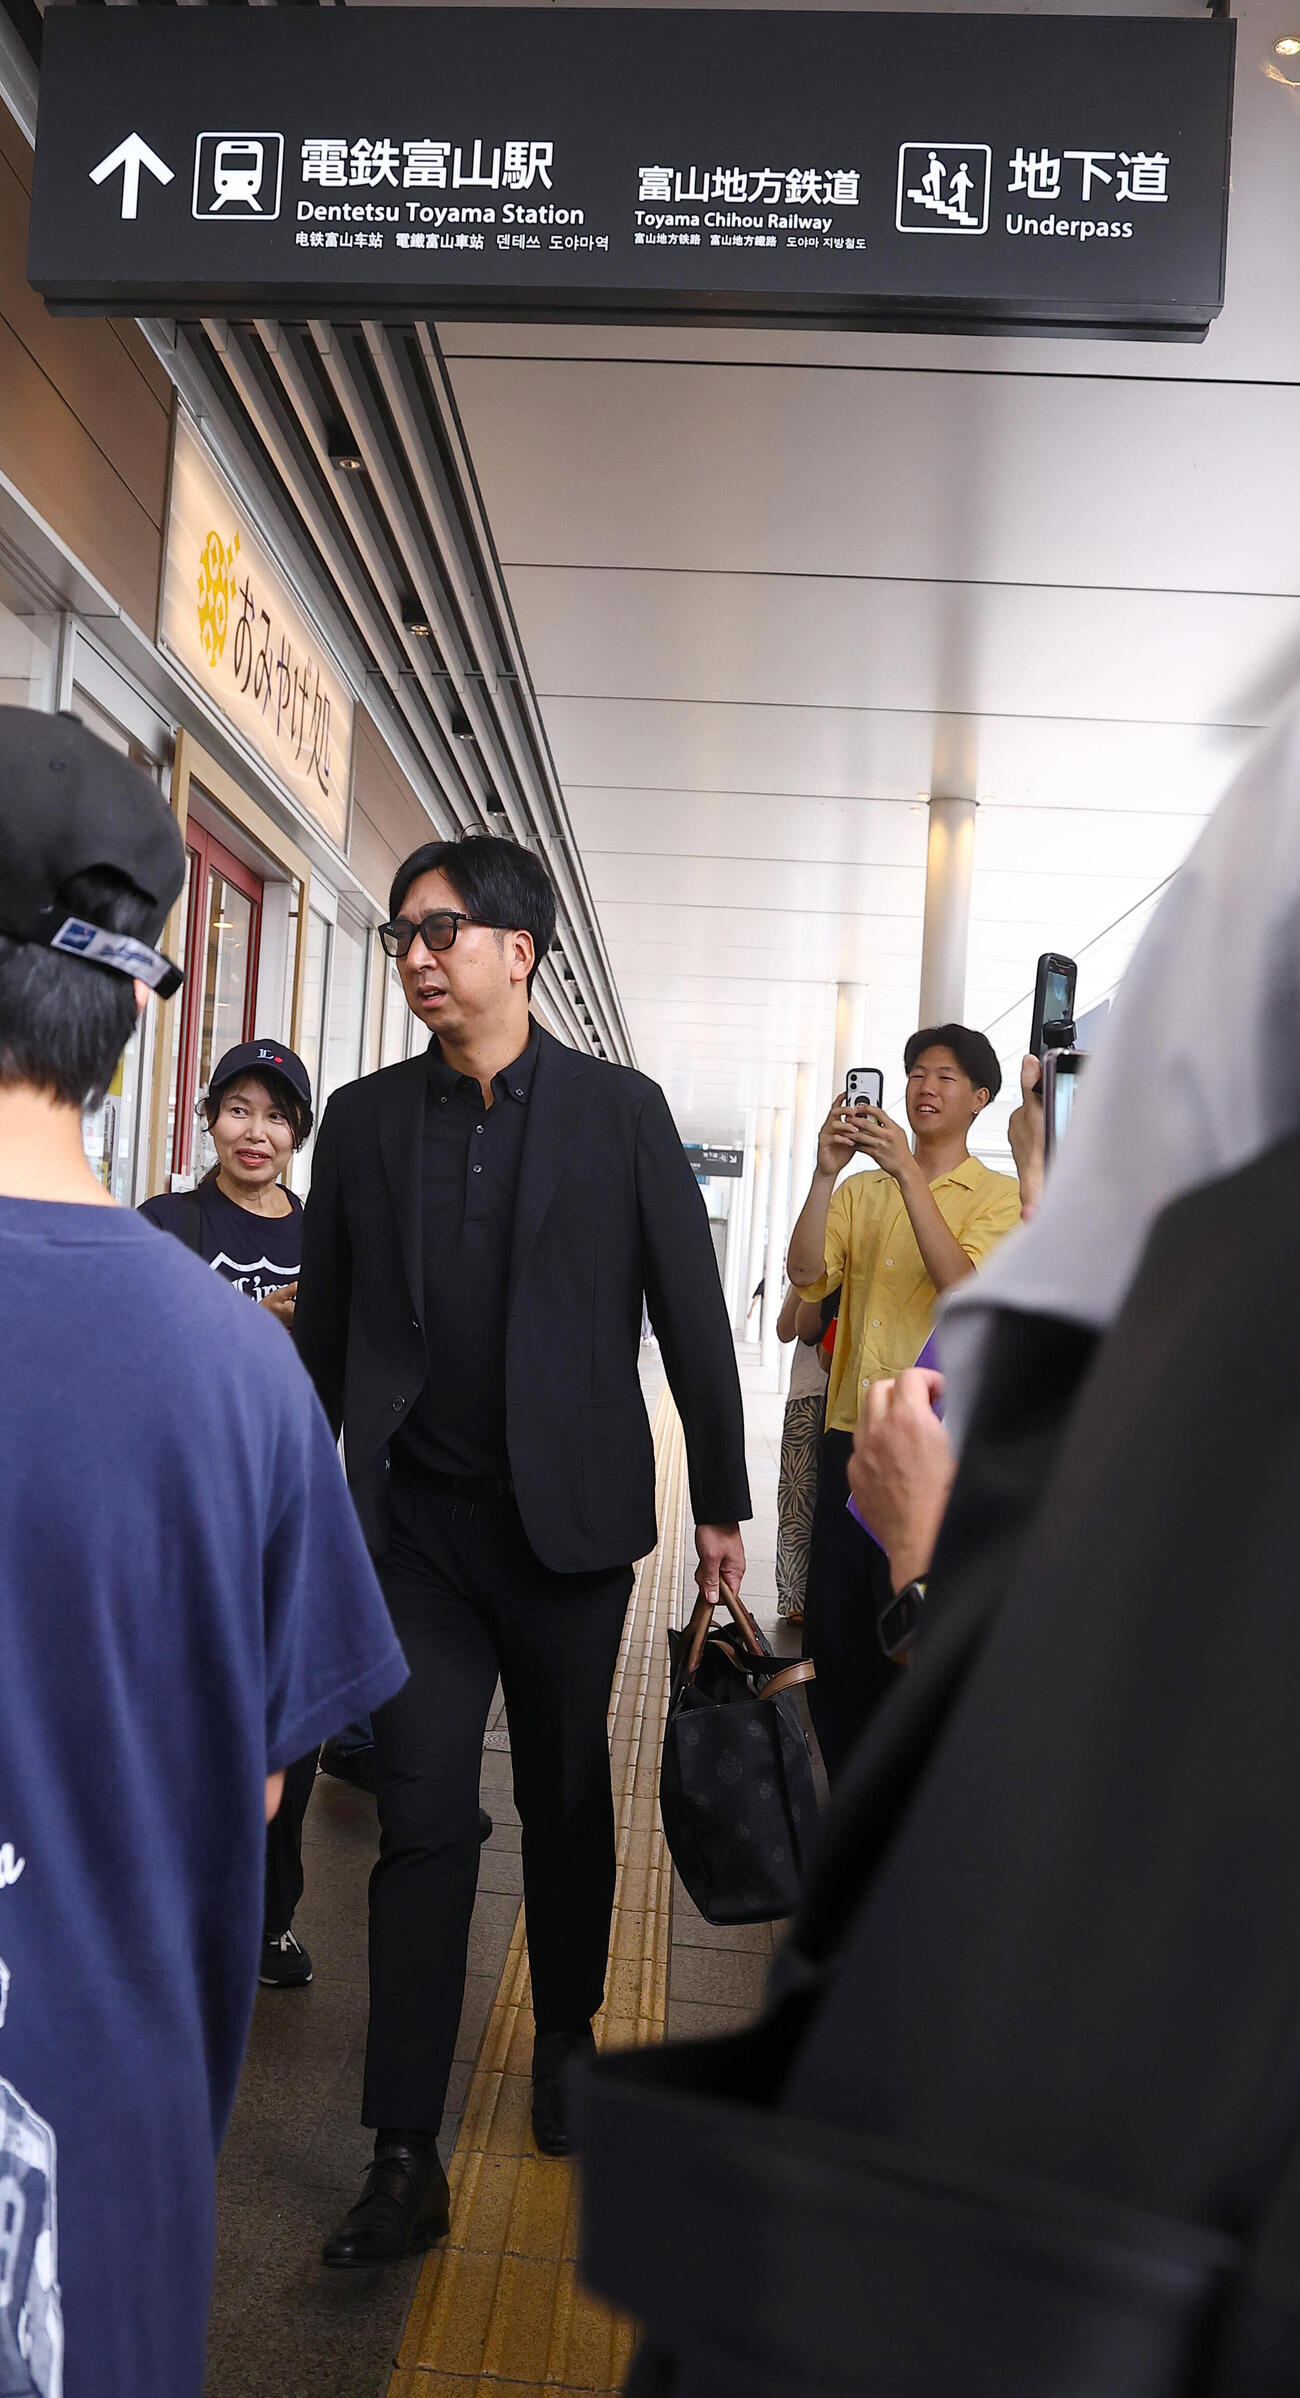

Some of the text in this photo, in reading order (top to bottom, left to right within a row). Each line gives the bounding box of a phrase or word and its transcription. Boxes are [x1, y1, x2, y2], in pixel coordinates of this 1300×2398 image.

[301, 137, 554, 190] 電鉄富山駅
[1007, 147, 1170, 202] 地下道
[638, 165, 861, 205] 富山地方鉄道
[296, 200, 584, 227] Dentetsu Toyama Station
[634, 210, 833, 233] Toyama Chihou Railway
[1006, 213, 1133, 241] Underpass
[295, 230, 384, 248] 电铁富山车站
[496, 233, 609, 251] 덴테쓰 도야마역
[785, 236, 867, 250] 도야마 지방철도
[234, 575, 330, 798] おみやげ処
